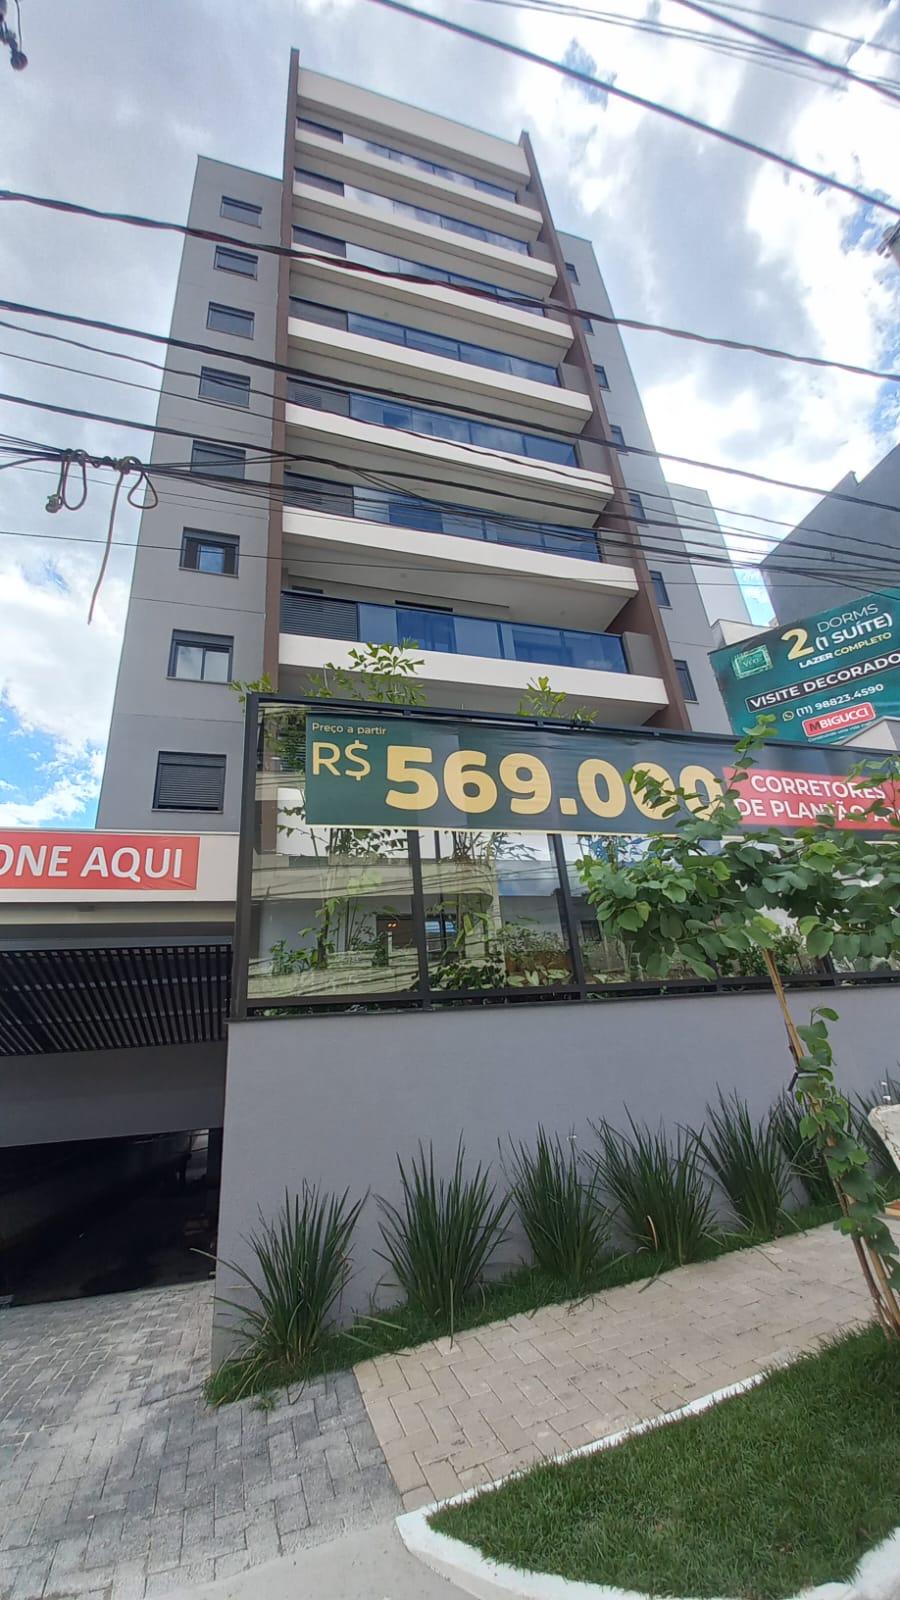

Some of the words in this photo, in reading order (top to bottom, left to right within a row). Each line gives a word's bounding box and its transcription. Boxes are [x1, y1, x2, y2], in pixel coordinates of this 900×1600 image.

[816, 636, 830, 651] (1
[832, 612, 893, 644] SUÍTE)
[817, 603, 879, 633] DORMS
[781, 628, 816, 660] 2
[799, 653, 834, 669] LAZER
[834, 632, 892, 657] COMPLETO
[749, 684, 800, 709] VISITE
[804, 653, 900, 692] DECORADO
[796, 705, 813, 717] (11)
[815, 683, 884, 711] 98823.4590
[312, 722, 344, 734] Preço
[357, 725, 387, 736] partir
[810, 708, 869, 731] MBIGUCCI
[312, 740, 371, 781] R$
[385, 745, 726, 821] 569.000
[751, 775, 886, 800] CORRETORES
[736, 798, 766, 817] DE
[80, 846, 183, 883] AQUI
